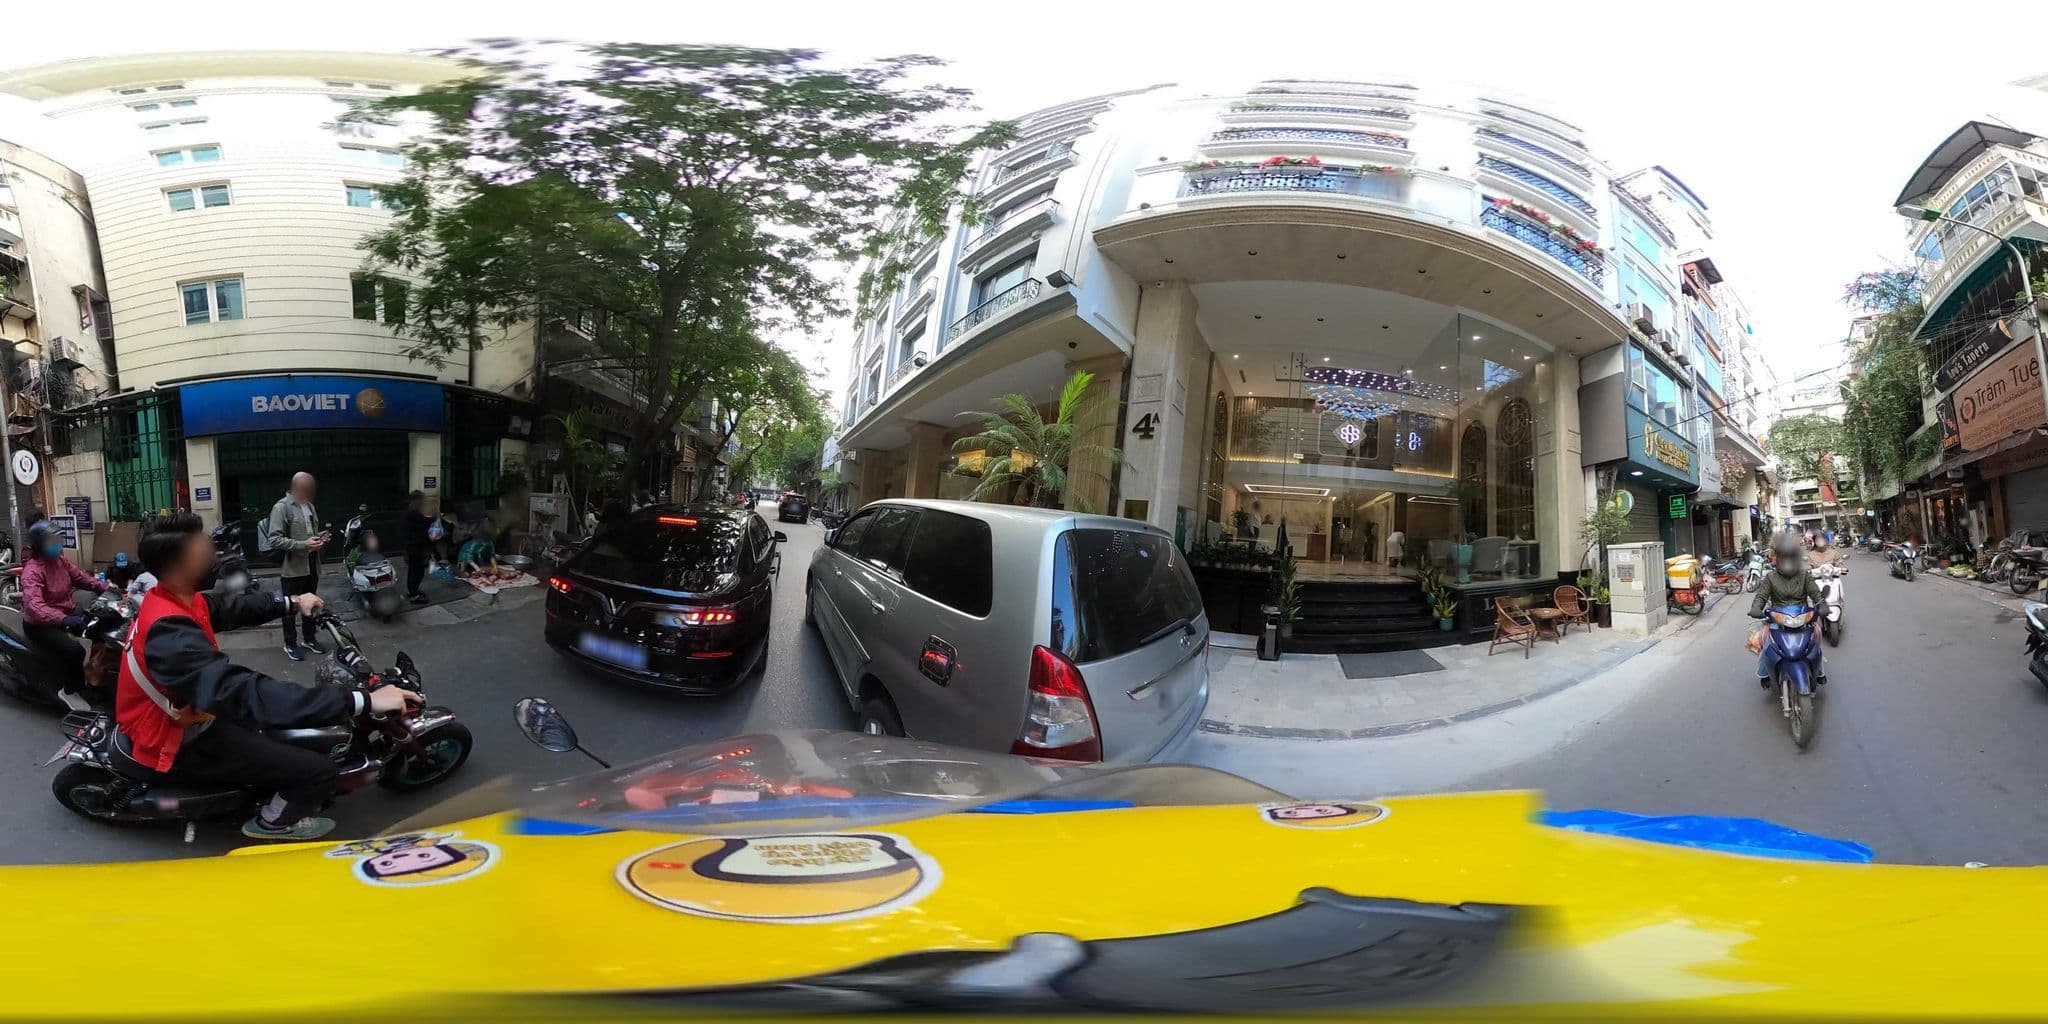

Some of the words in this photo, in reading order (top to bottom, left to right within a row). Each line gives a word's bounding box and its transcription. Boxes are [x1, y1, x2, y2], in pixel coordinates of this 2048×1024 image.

[1960, 342, 1990, 366] Tavern
[2008, 357, 2041, 387] Tuệ
[251, 393, 351, 413] BAOVIET
